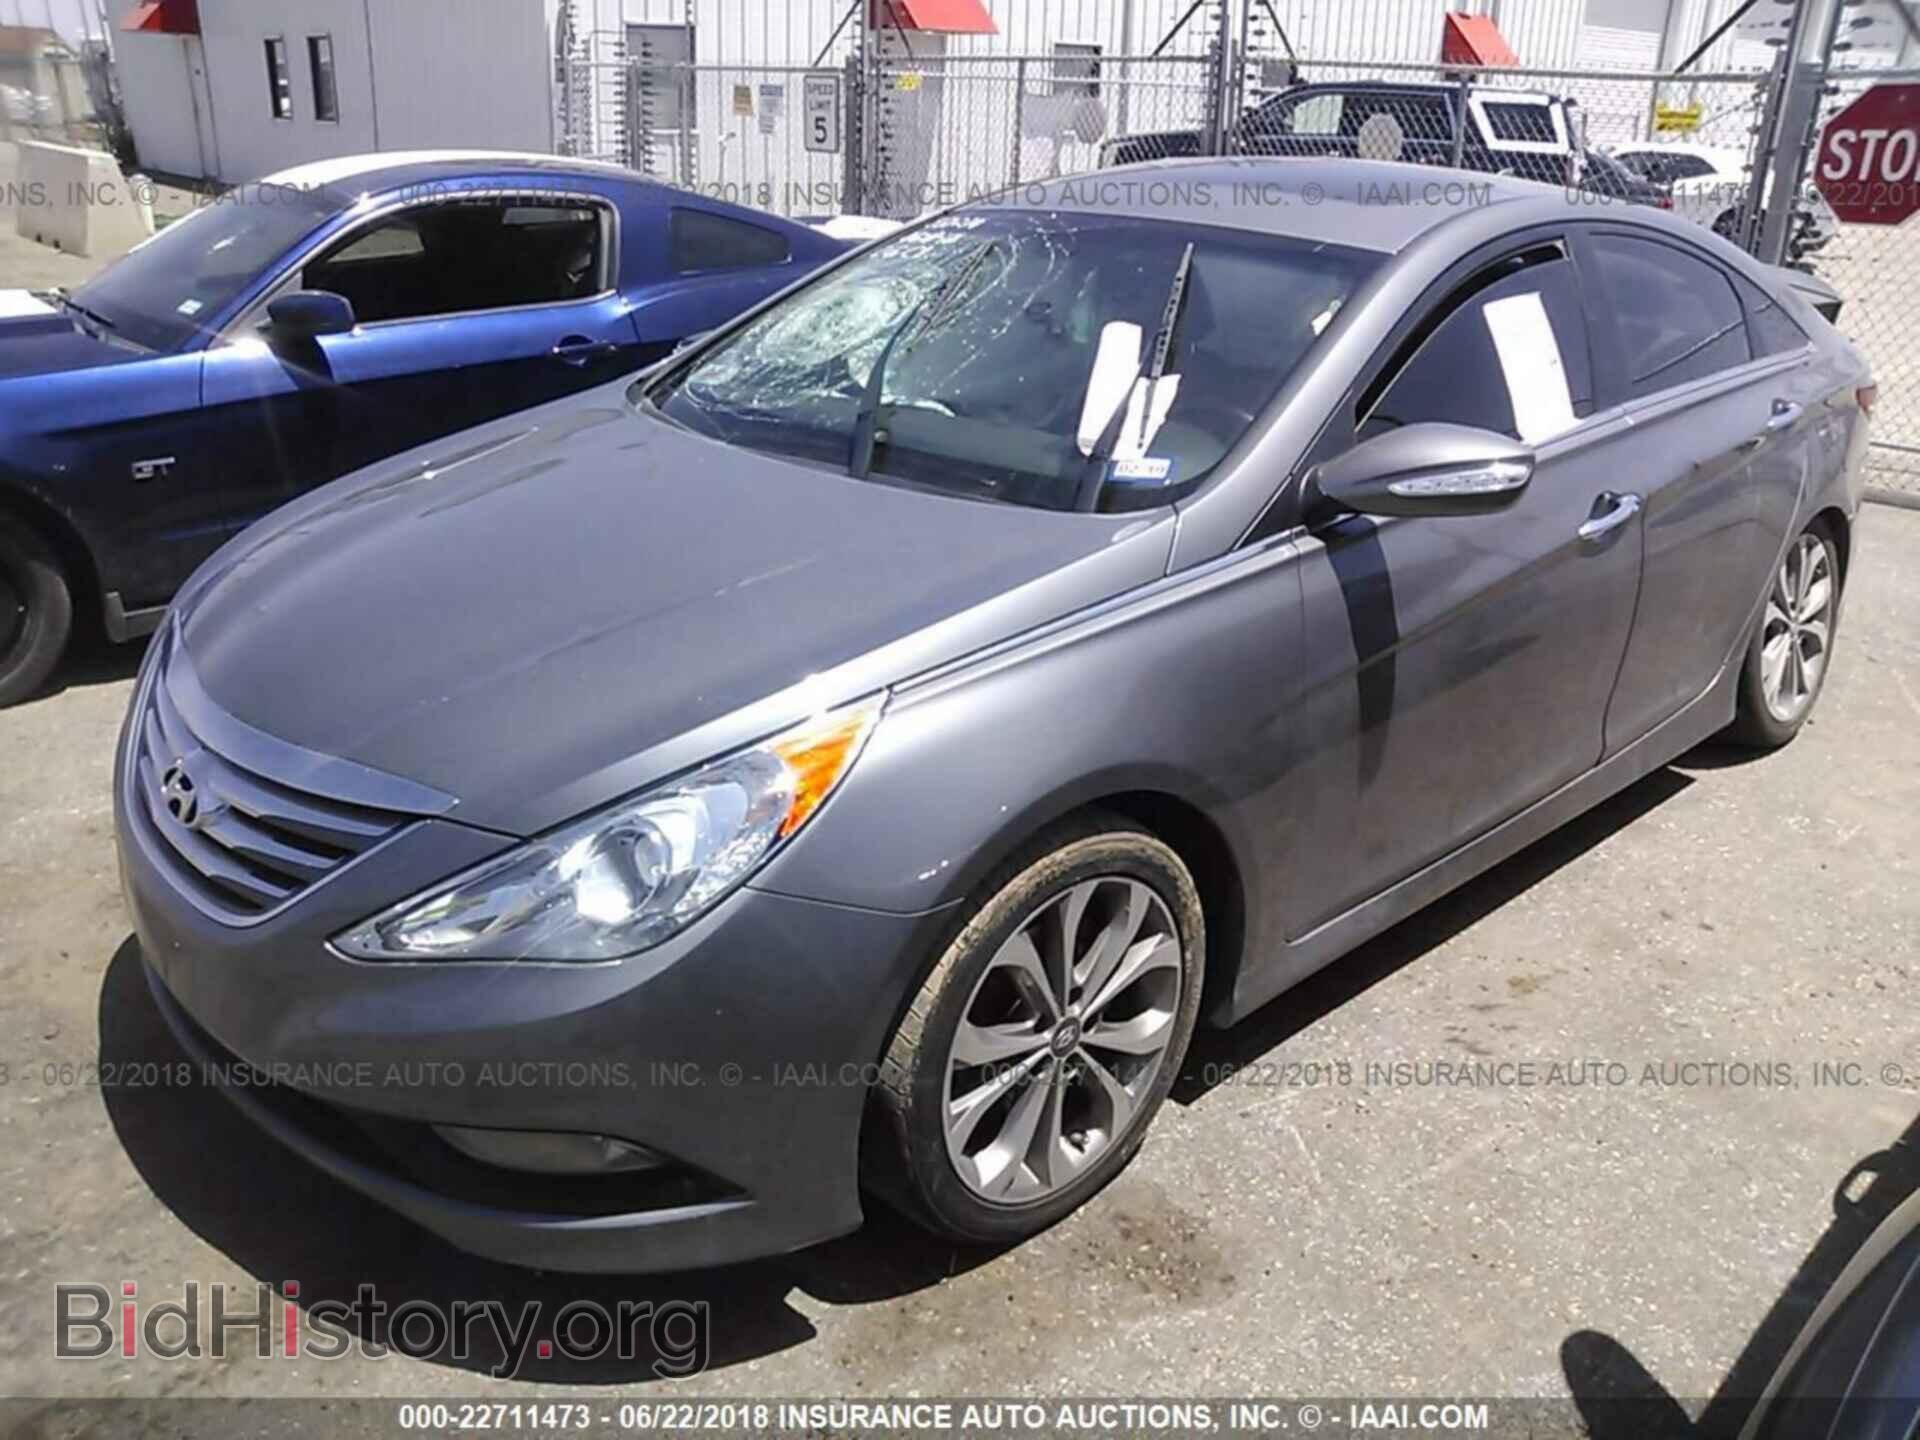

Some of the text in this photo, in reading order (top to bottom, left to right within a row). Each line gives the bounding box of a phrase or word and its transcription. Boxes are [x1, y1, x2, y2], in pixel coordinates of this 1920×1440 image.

[807, 83, 834, 95] SPEED
[814, 116, 828, 144] 5
[1822, 128, 1920, 182] STO
